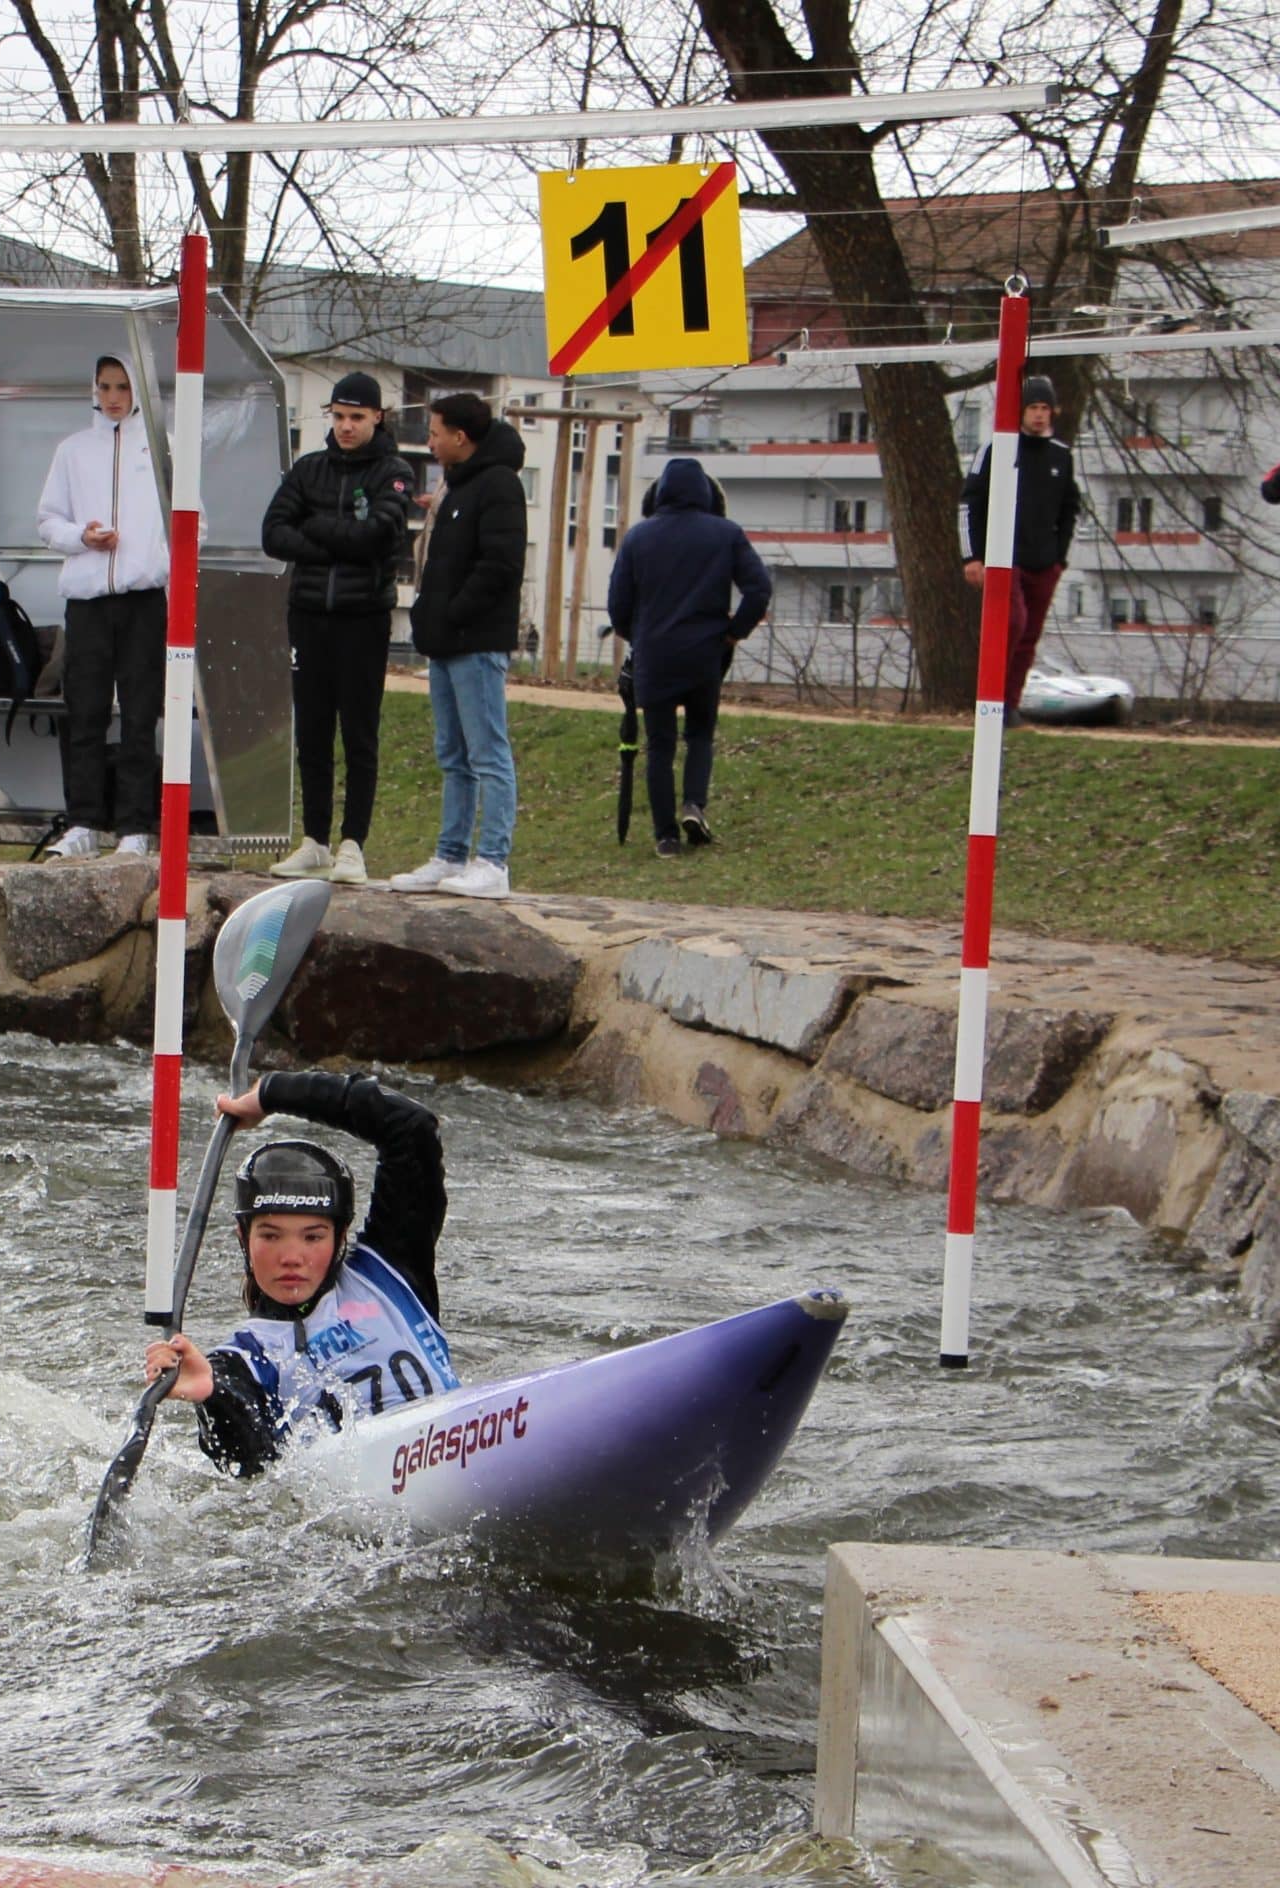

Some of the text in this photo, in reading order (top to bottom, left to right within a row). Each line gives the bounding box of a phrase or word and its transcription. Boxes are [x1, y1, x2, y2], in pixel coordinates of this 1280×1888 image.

[570, 198, 710, 337] 11
[253, 1192, 332, 1209] galasport
[392, 1396, 529, 1495] galasport
